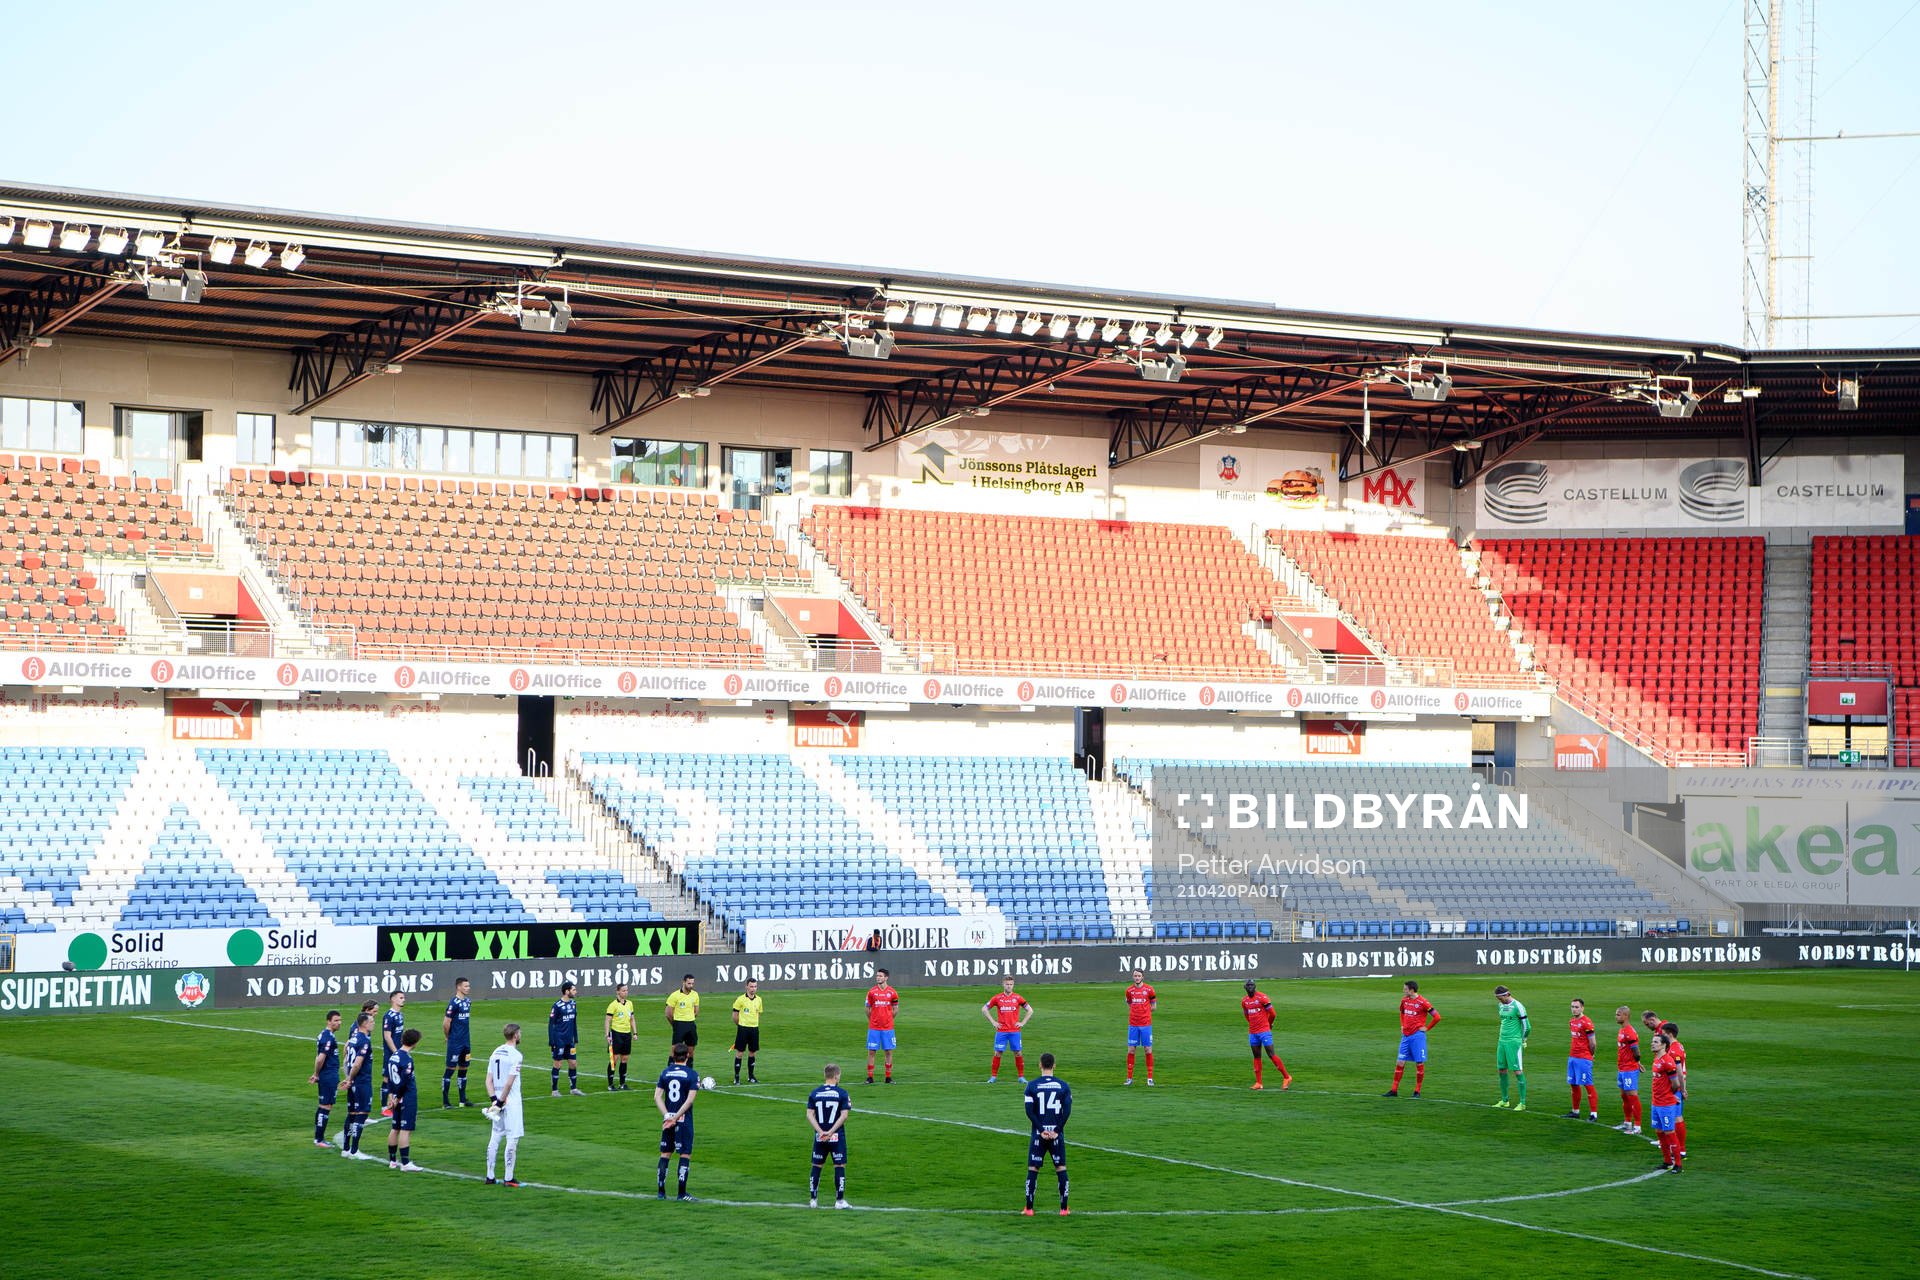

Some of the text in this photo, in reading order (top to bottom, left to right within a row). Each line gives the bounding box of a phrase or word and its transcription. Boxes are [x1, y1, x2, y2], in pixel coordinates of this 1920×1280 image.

[959, 458, 1097, 479] Jönssons Plåtslageri
[972, 475, 1085, 495] i Helsingborg AB
[1363, 467, 1417, 509] MAX
[1563, 486, 1668, 502] CASTELLUM
[1775, 483, 1885, 499] CASTELLUM
[48, 662, 132, 678] AllOffice
[176, 665, 256, 681] AllOffice
[301, 668, 377, 684] AllOffice
[417, 671, 491, 686] AllOffice
[532, 673, 602, 688] AllOffice
[639, 676, 706, 691] AllOffice
[744, 679, 809, 693] AllOffice
[844, 681, 907, 695] AllOffice
[942, 683, 1004, 697] AllOffice
[1036, 685, 1095, 700] AllOffice
[1129, 688, 1187, 702] AllOffice
[1217, 690, 1273, 703] AllOffice
[1304, 692, 1358, 705] AllOffice
[1387, 694, 1441, 707] AllOffice
[1470, 696, 1522, 709] AllOffice
[1691, 806, 1900, 876] akea
[1715, 878, 1841, 891] PART OF ELEDA GROUP
[111, 932, 163, 953] Solid
[267, 929, 317, 949] Solid
[390, 931, 452, 962] XXL
[473, 930, 534, 960] XXL
[554, 928, 613, 958] XXL
[633, 927, 691, 956] XXL
[267, 953, 331, 966] Försäkring
[1119, 950, 1259, 972] NORDSTRÖMS
[1302, 947, 1435, 969] NORDSTRÖMS
[1476, 944, 1602, 966] NORDSTRÖMS
[1641, 942, 1761, 963] NORDSTRÖMS
[110, 957, 179, 970] Försäkring
[716, 958, 875, 983] NORDSTRÖMS
[924, 953, 1073, 977] NORDSTRÖMS
[246, 968, 434, 998] NORDSTRÖMS
[491, 963, 663, 989] NORDSTRÖMS
[1, 974, 152, 1010] SUPERETTAN
[494, 1059, 501, 1080] 1
[668, 1079, 681, 1103] 8
[815, 1100, 839, 1124] 17
[1037, 1091, 1062, 1115] 14
